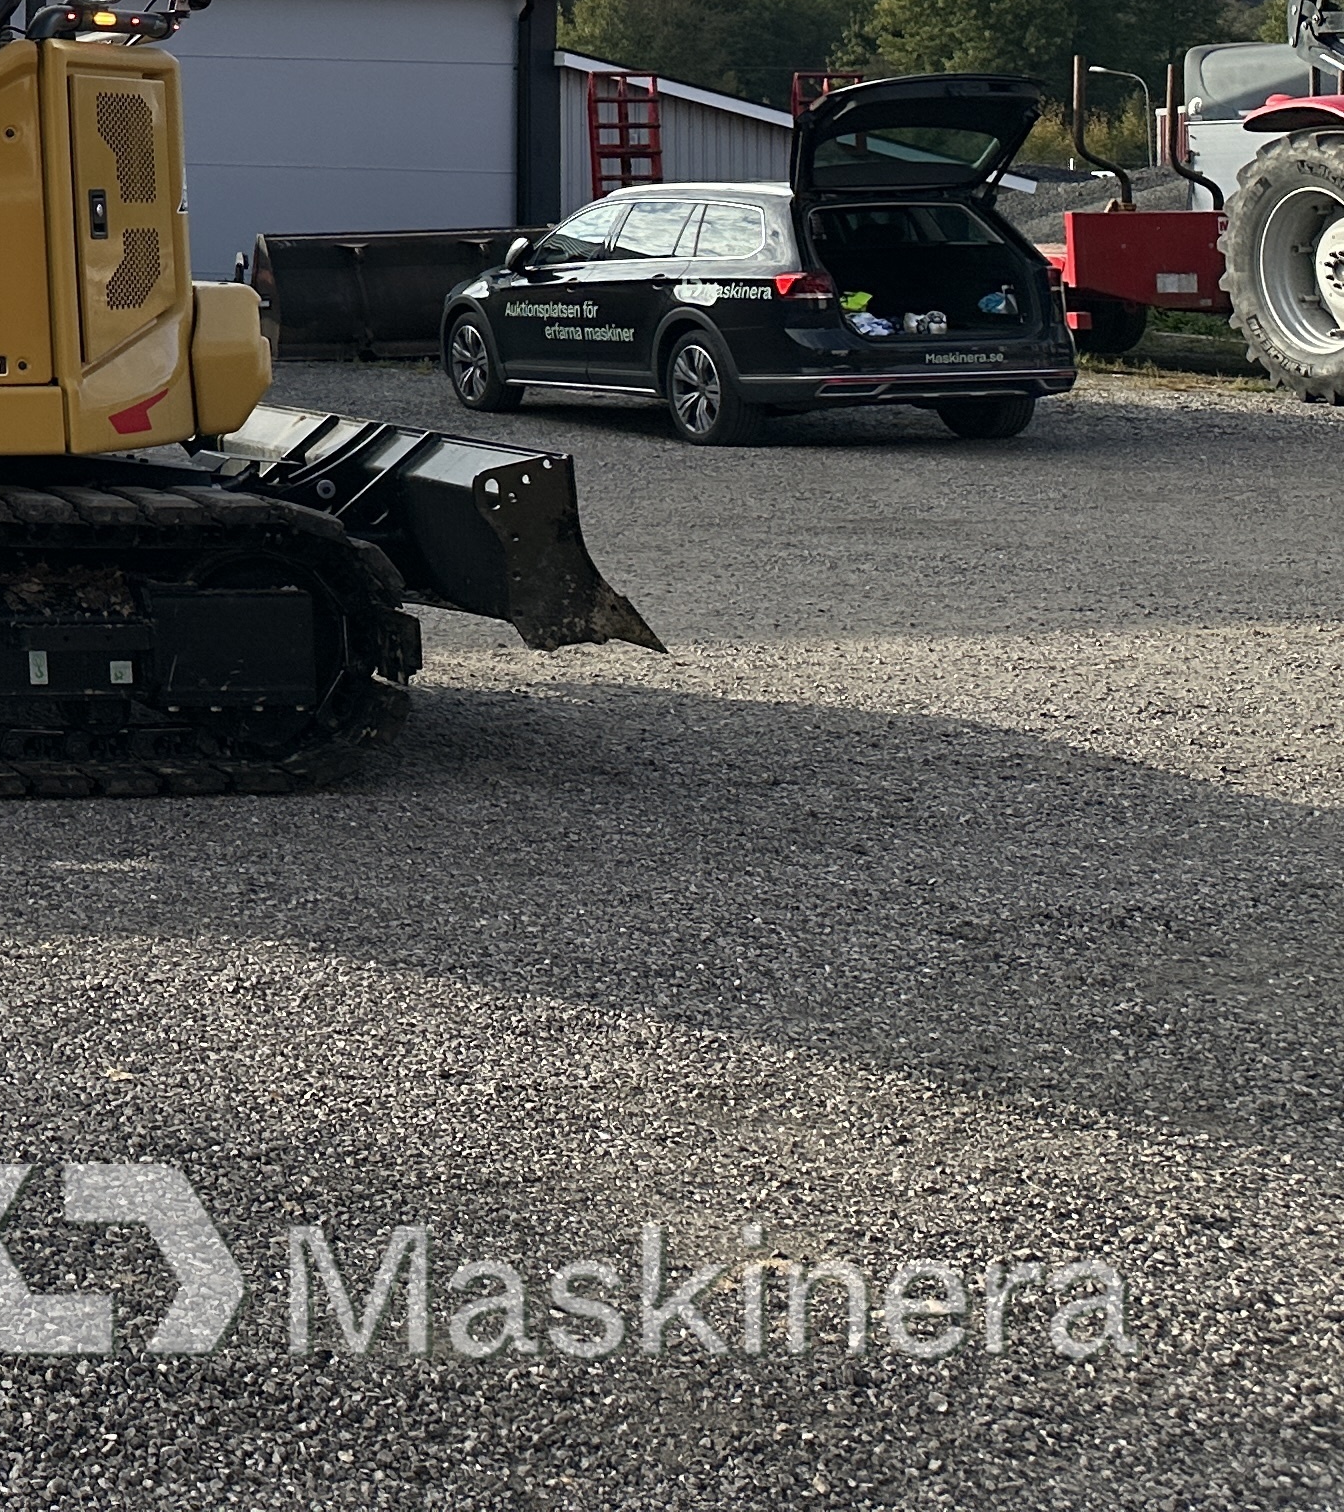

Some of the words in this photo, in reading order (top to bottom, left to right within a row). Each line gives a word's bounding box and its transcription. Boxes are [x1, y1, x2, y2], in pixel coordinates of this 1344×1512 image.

[505, 301, 580, 320] Auktionsplatsen
[583, 300, 599, 318] för
[544, 322, 583, 340] erfarna
[584, 324, 635, 342] maskiner
[925, 351, 1004, 364] Maskinera.se
